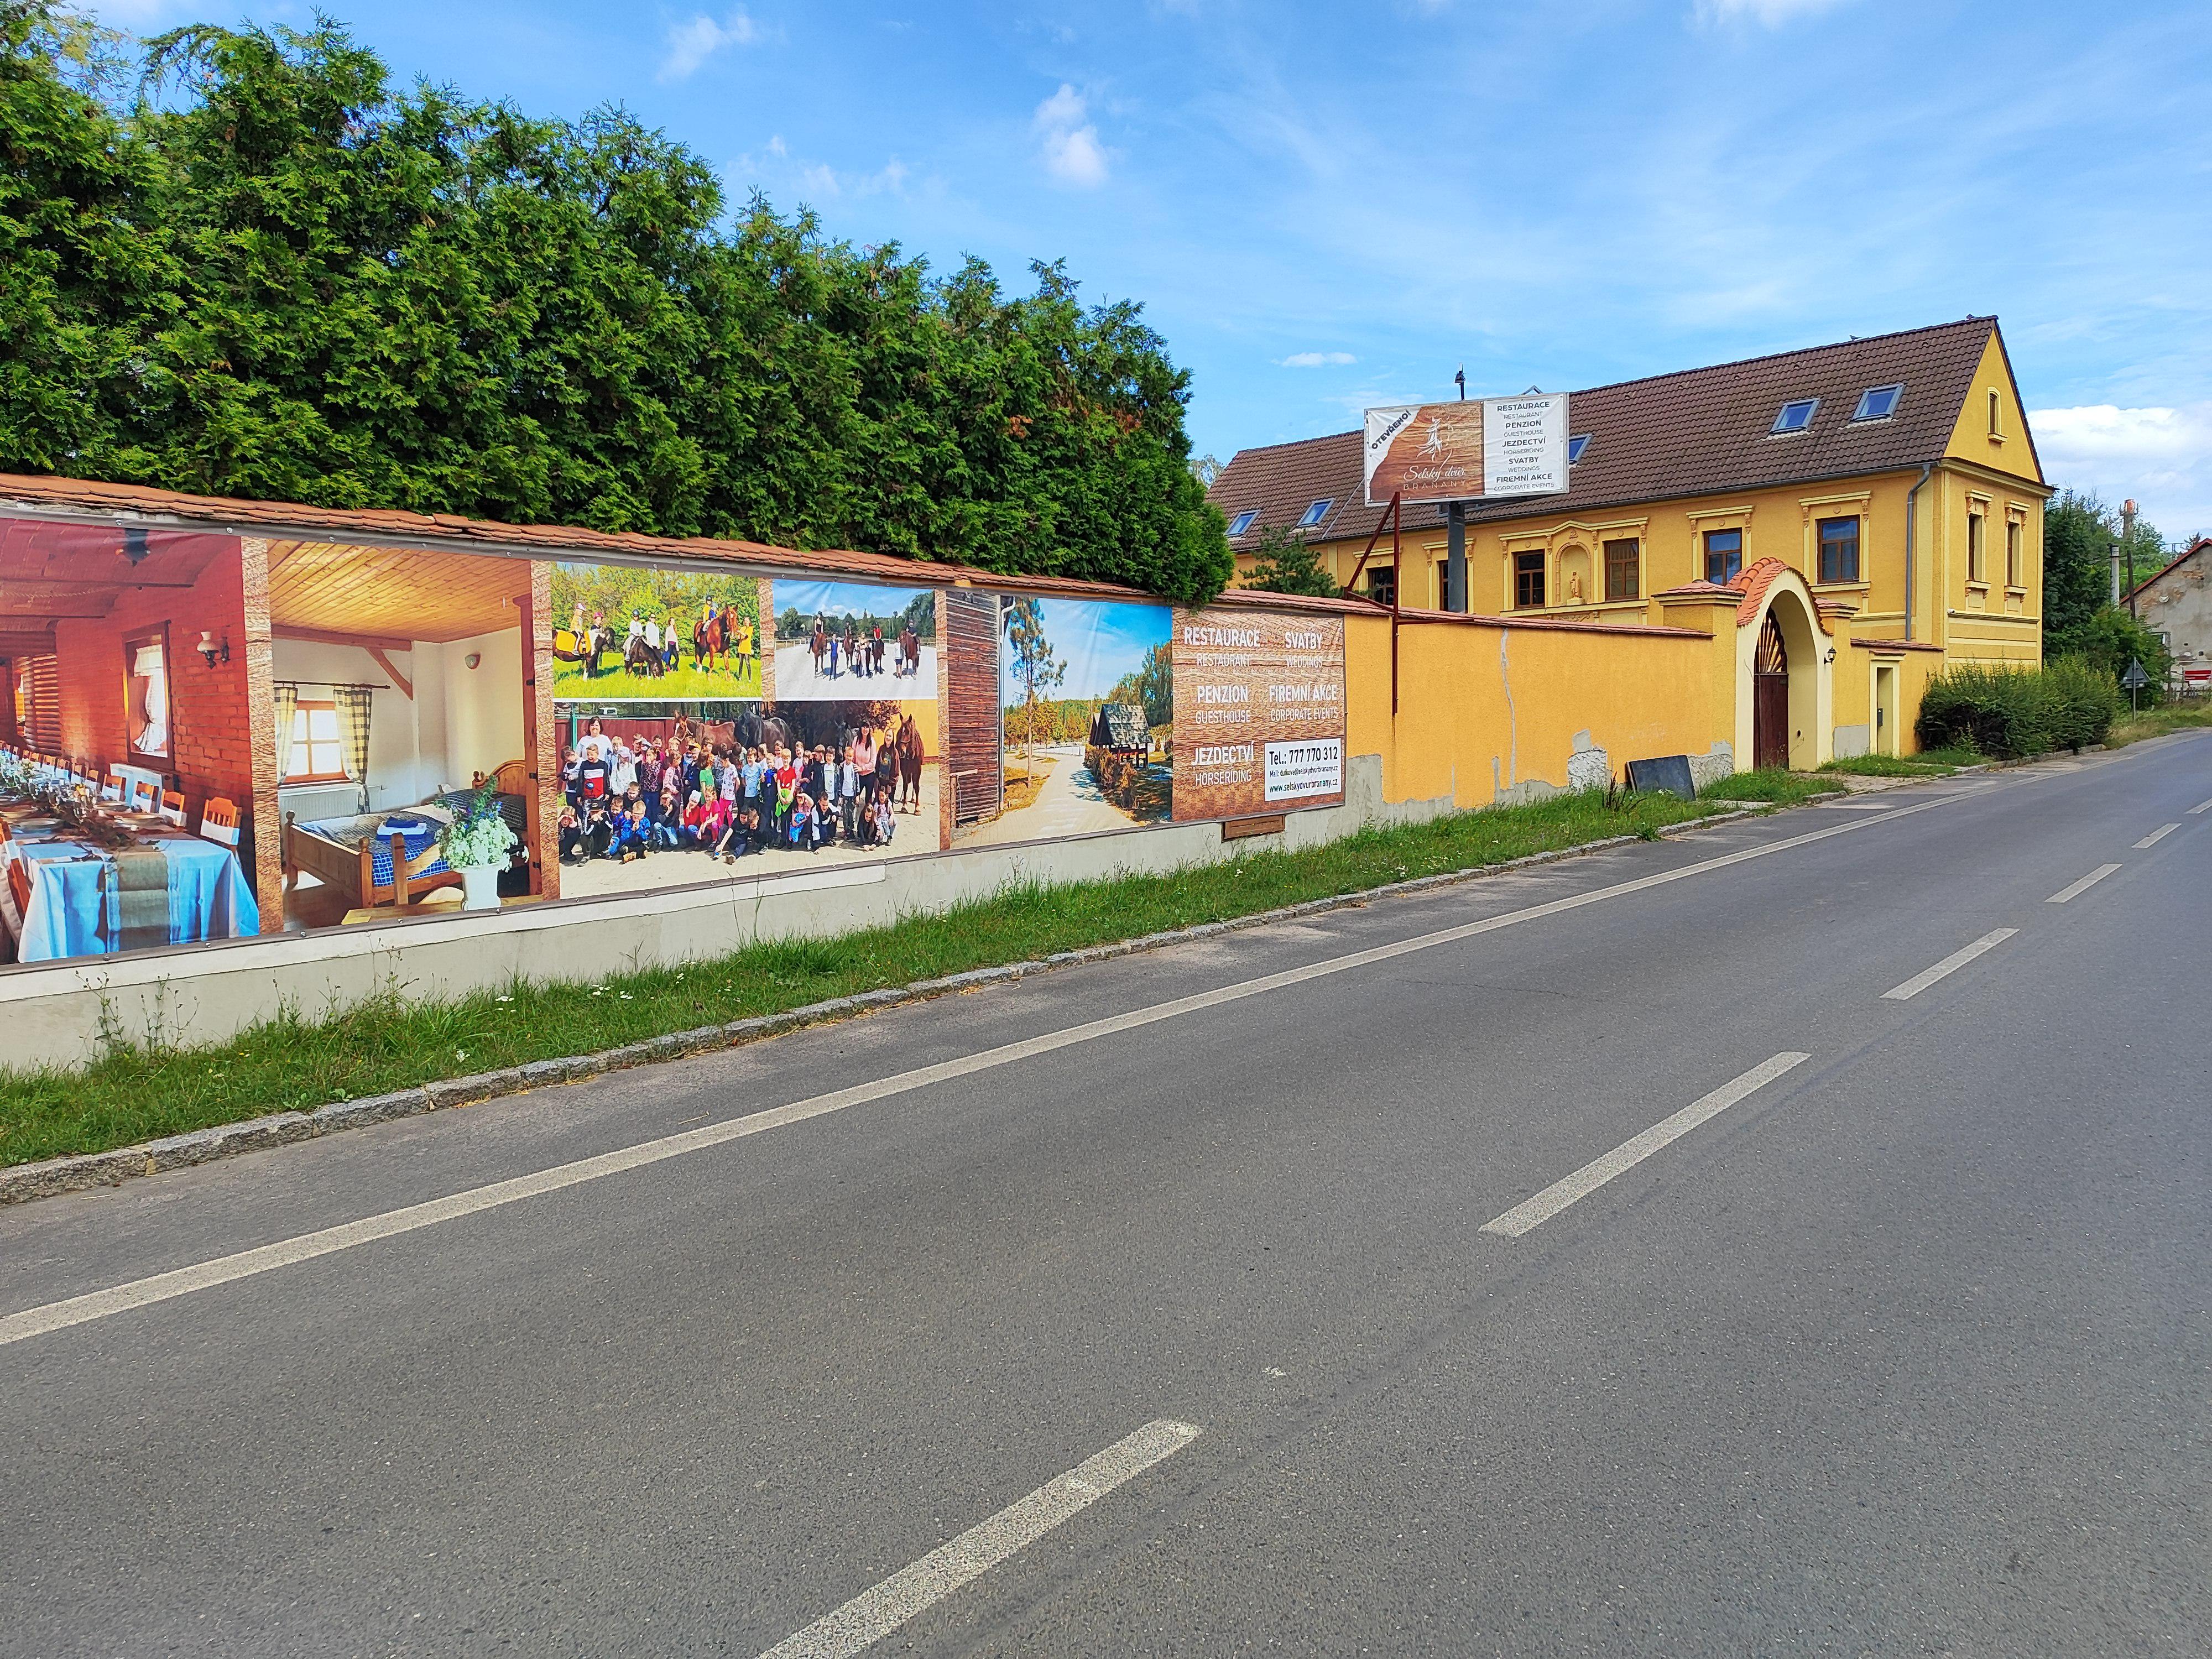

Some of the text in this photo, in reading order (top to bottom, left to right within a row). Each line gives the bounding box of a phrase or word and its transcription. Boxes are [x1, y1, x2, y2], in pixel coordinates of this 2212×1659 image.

[1498, 401, 1550, 411] RESTAURACE
[1371, 409, 1411, 450] OTEVŘENO!
[1505, 420, 1541, 429] PENZION
[1502, 436, 1546, 447] JEZDECTVÍ
[1496, 473, 1528, 483] FIREMNÍ
[1184, 626, 1260, 647] RESTAURACE
[1285, 632, 1323, 650] SVATBY
[1197, 653, 1250, 667] RESTAURANT
[1286, 656, 1323, 668] WEDDINGS
[1197, 685, 1248, 703] PENZION
[1269, 681, 1338, 702] FIREMNÍ AKCE
[1195, 709, 1251, 724] GUESTHOUSE
[1271, 706, 1338, 722] CORPORATE EVENTS
[1191, 740, 1254, 766] JEZDECTVÍ
[1269, 747, 1338, 765] Tel.: 777 770 312
[1195, 769, 1252, 786] HORSERIDING
[1269, 779, 1338, 792] www.selskydvurbranany.cz
